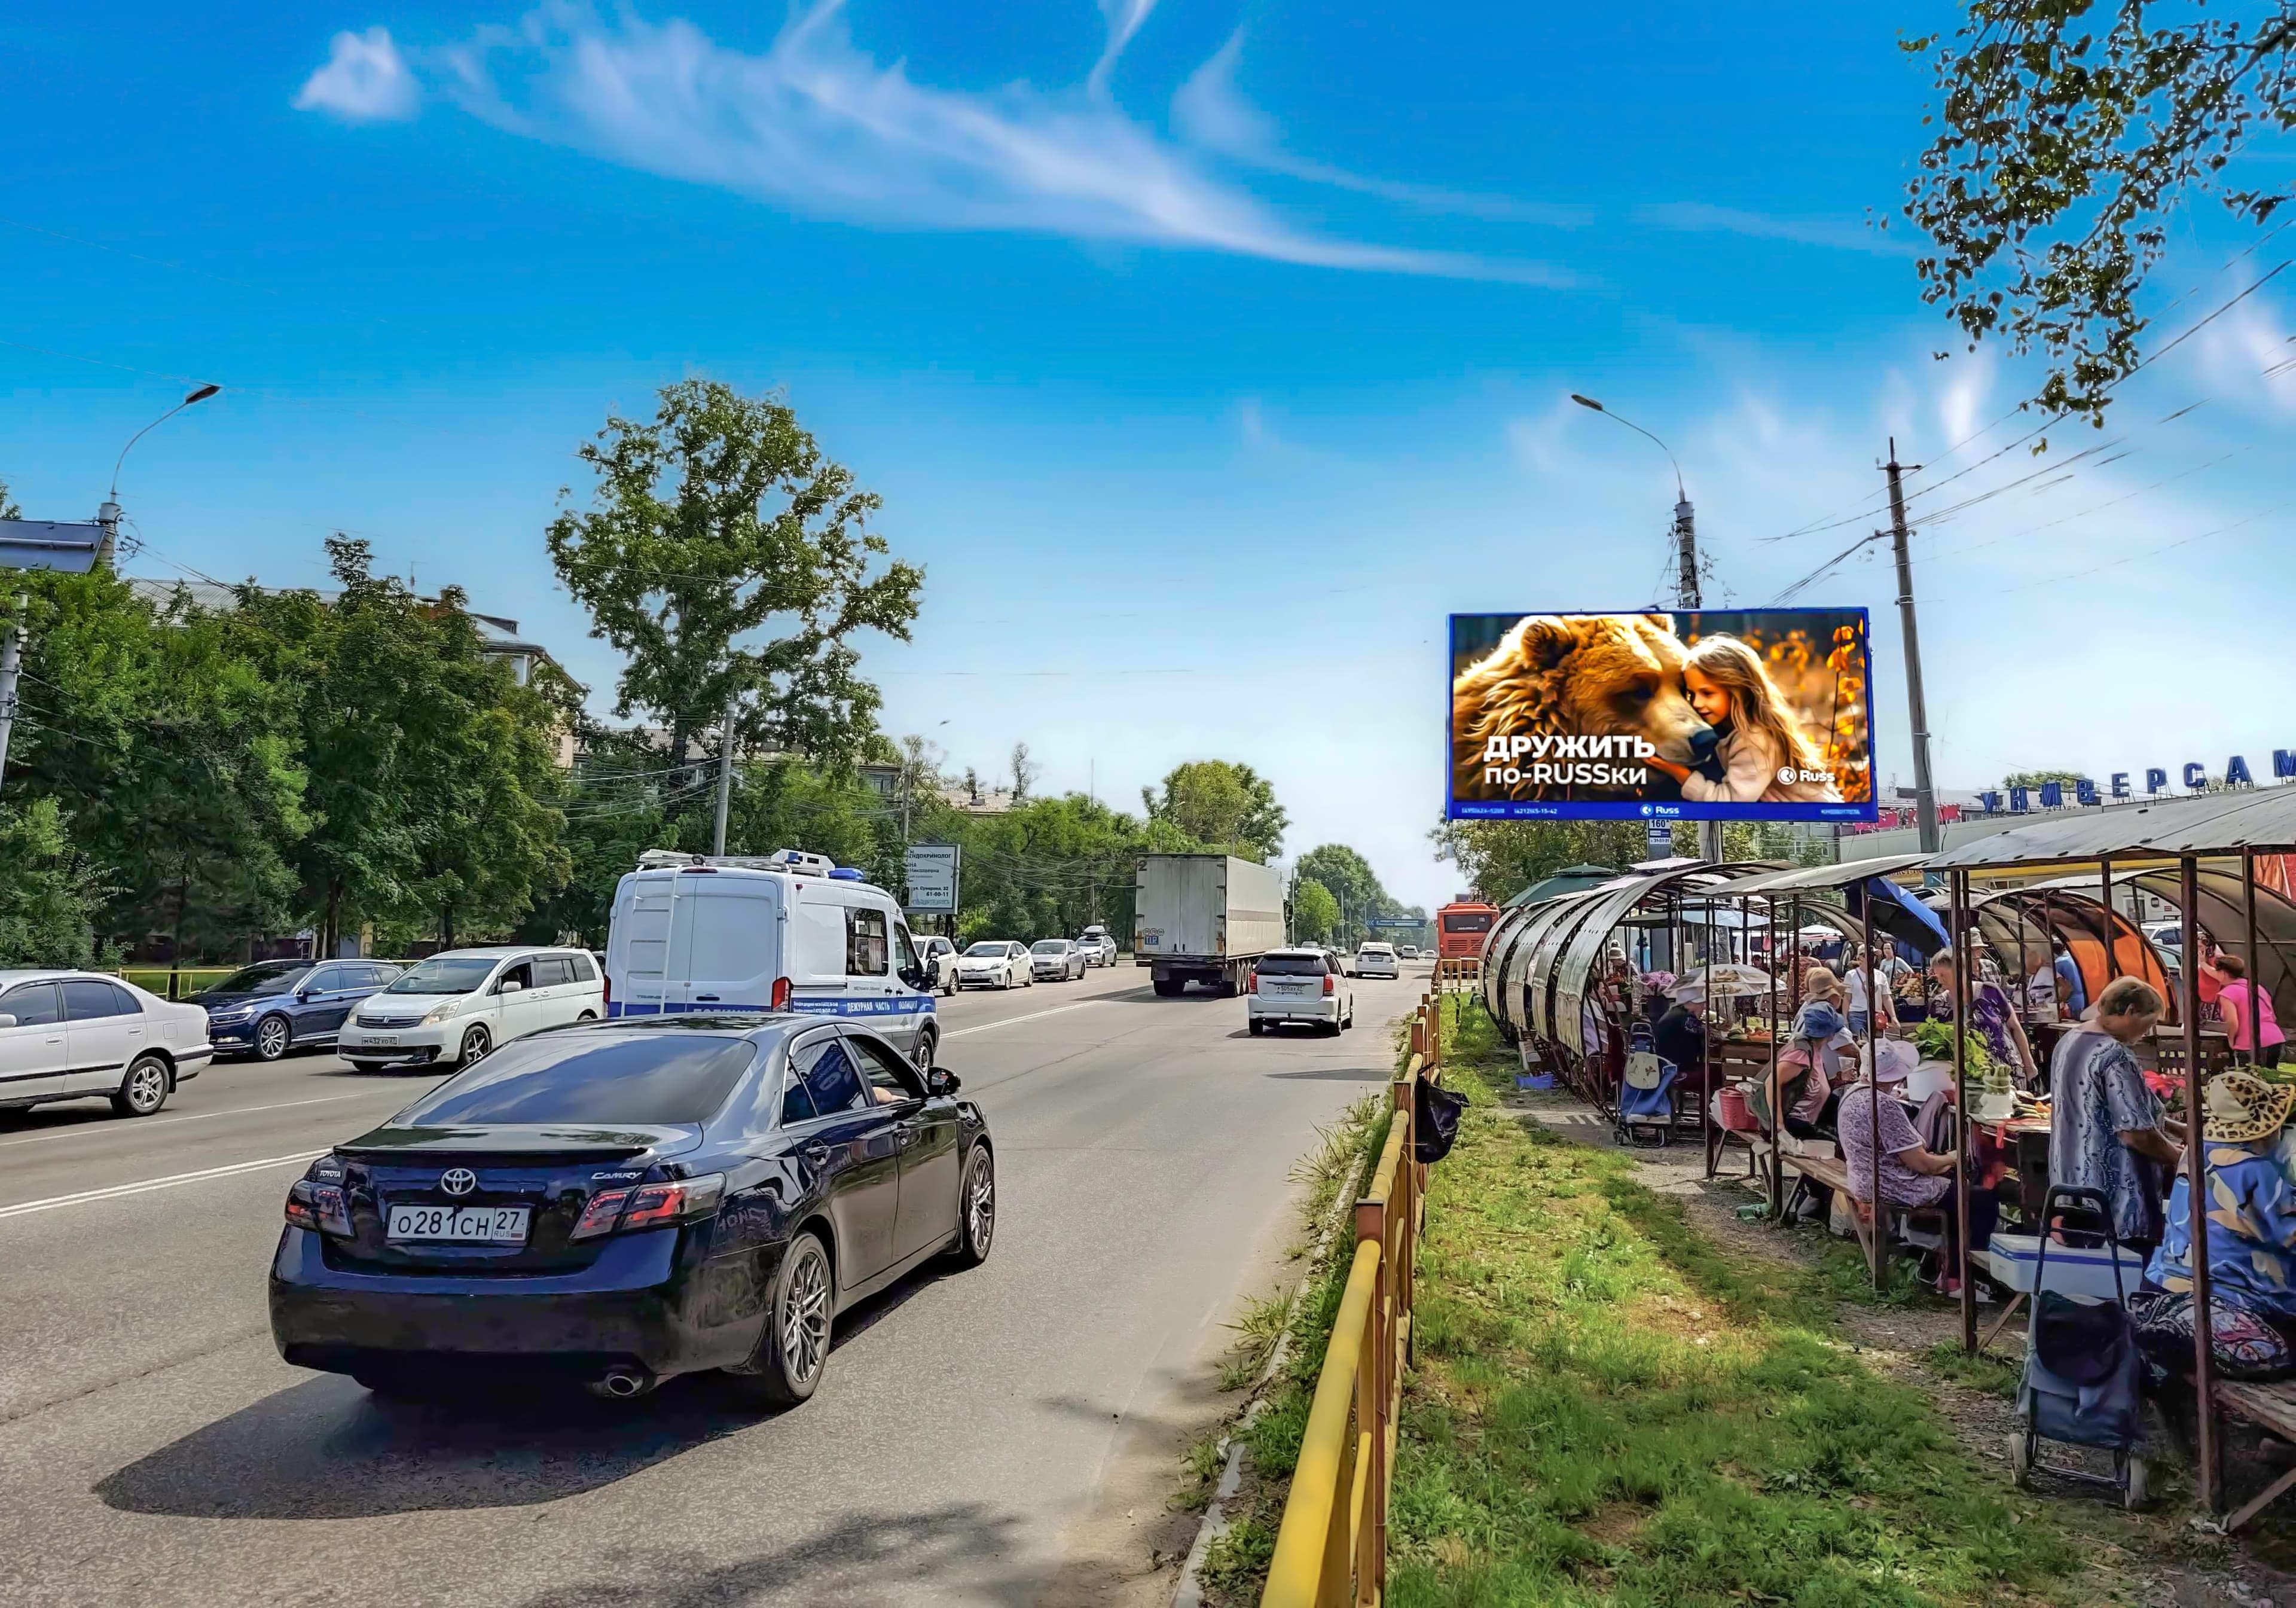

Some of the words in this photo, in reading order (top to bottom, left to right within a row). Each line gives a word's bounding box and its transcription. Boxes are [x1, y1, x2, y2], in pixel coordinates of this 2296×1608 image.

[1483, 736, 1656, 762] ДРУЖИТЬ
[1485, 763, 1647, 785] по-RUSSки
[1800, 770, 1836, 782] Russ
[847, 1002, 873, 1013] ДЕЖУРНАЯ
[875, 1001, 890, 1011] ЧАСТЬ
[496, 1212, 520, 1229] 27
